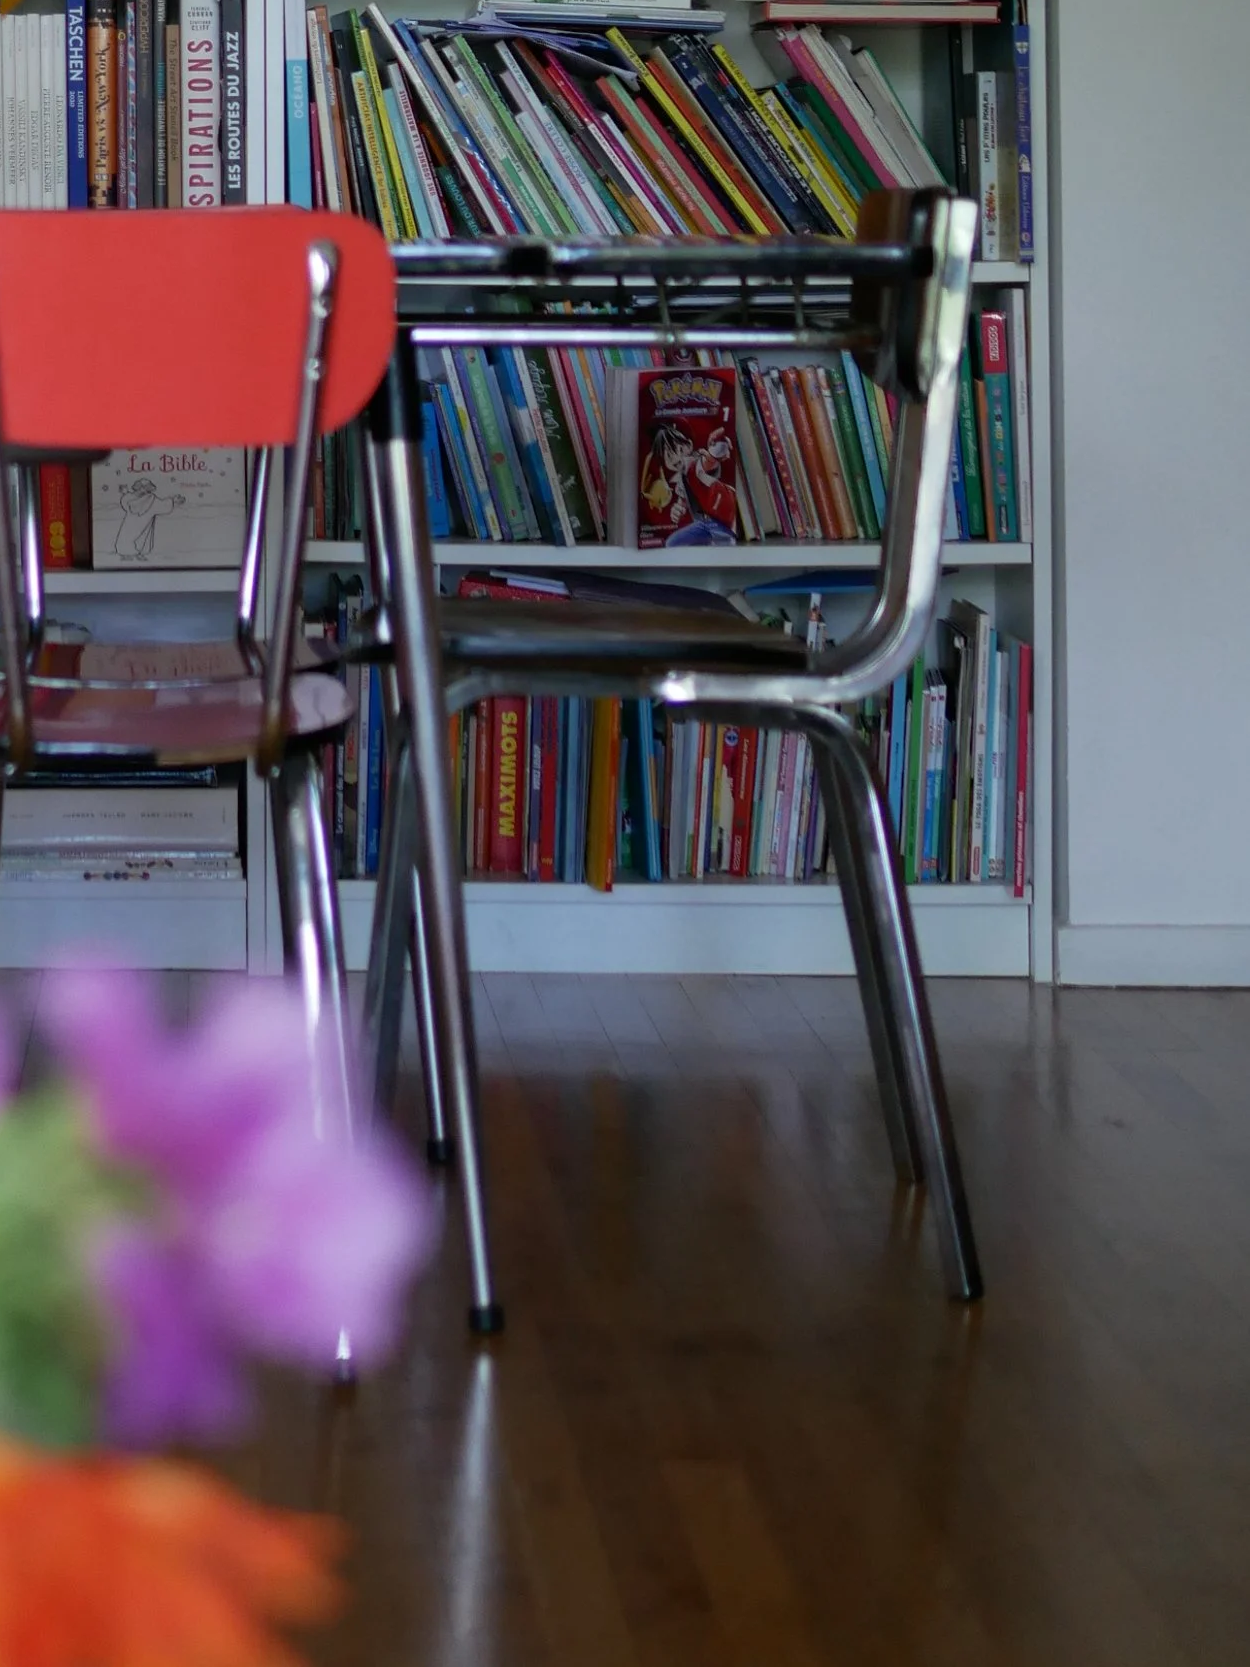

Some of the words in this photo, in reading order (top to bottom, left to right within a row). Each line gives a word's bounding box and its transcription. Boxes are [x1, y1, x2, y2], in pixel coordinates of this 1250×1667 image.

[69, 5, 84, 82] TASCHEN
[225, 31, 240, 72] JAZZ
[227, 74, 240, 98] DU
[293, 64, 304, 120] OCEANO
[227, 99, 242, 160] ROUTES
[95, 136, 110, 168] Paris
[158, 148, 166, 176] PARFUM
[158, 178, 166, 186] LE
[227, 163, 242, 190] LES
[723, 407, 730, 424] 1
[128, 454, 154, 472] La
[159, 454, 208, 472] Bible
[498, 710, 520, 838] MAXIMOTS
